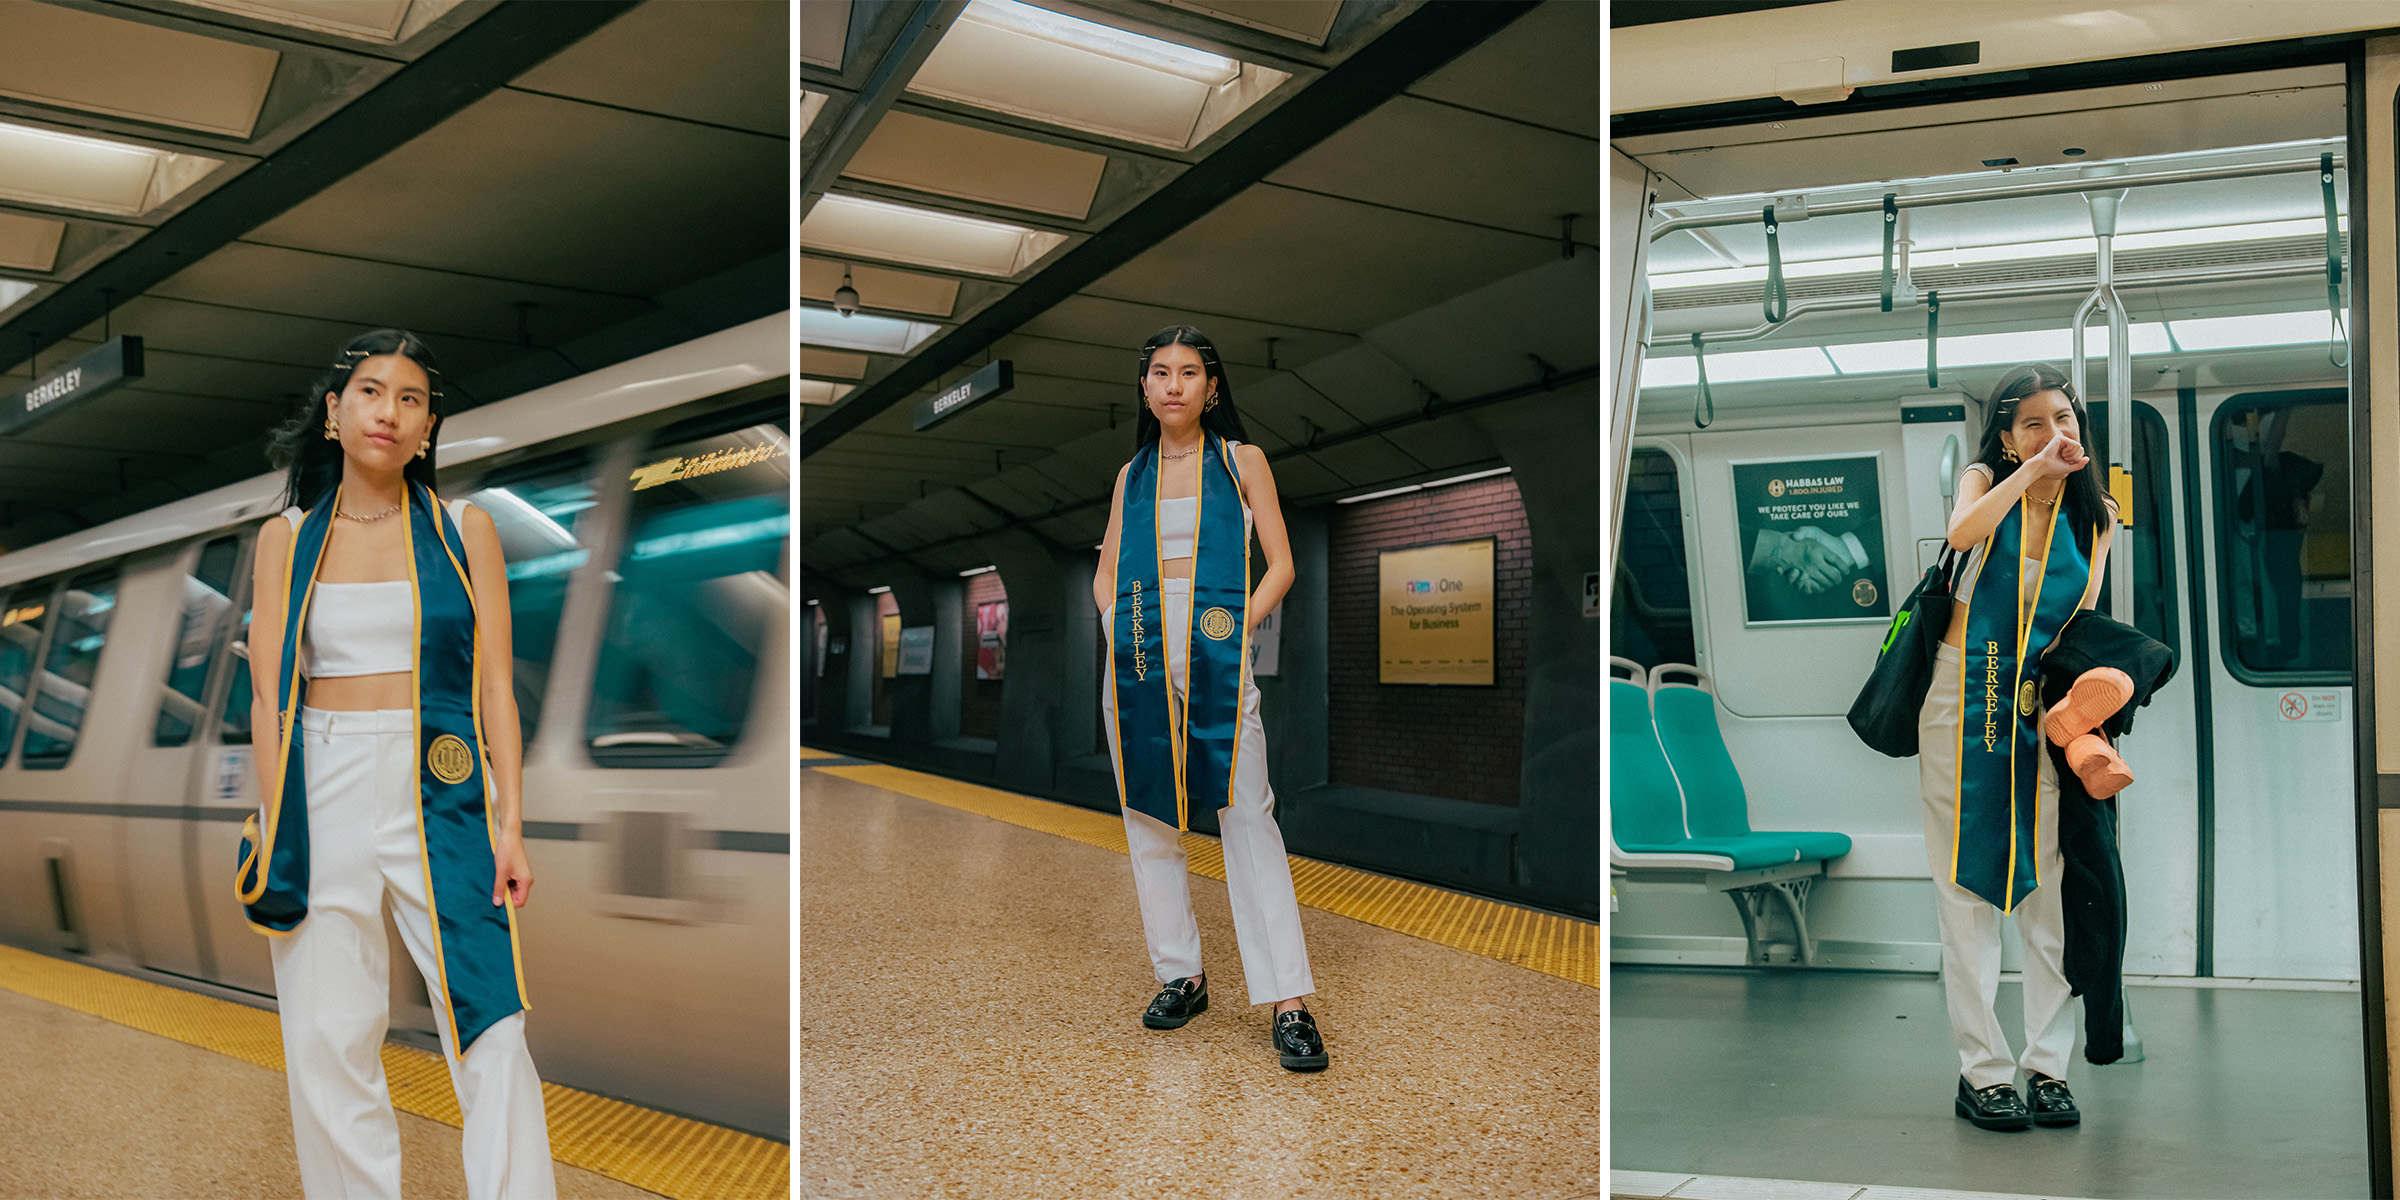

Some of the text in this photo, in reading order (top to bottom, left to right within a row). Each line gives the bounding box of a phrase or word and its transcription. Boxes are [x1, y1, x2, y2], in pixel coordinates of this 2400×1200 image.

[26, 366, 82, 412] BERKELEY
[933, 382, 972, 415] BERKELEY
[1785, 476, 1844, 488] HABBAS LAW
[1758, 501, 1860, 514] WE PROTECT YOU LIKE WE
[1770, 512, 1789, 520] TAKE
[1791, 511, 1811, 519] CARE
[1827, 509, 1849, 517] OURS
[1439, 578, 1463, 592] One
[1391, 601, 1482, 616] The Operating System
[1131, 580, 1147, 681] BERKELEY
[1409, 618, 1459, 630] for Business
[1984, 641, 1999, 752] BERKELEY
